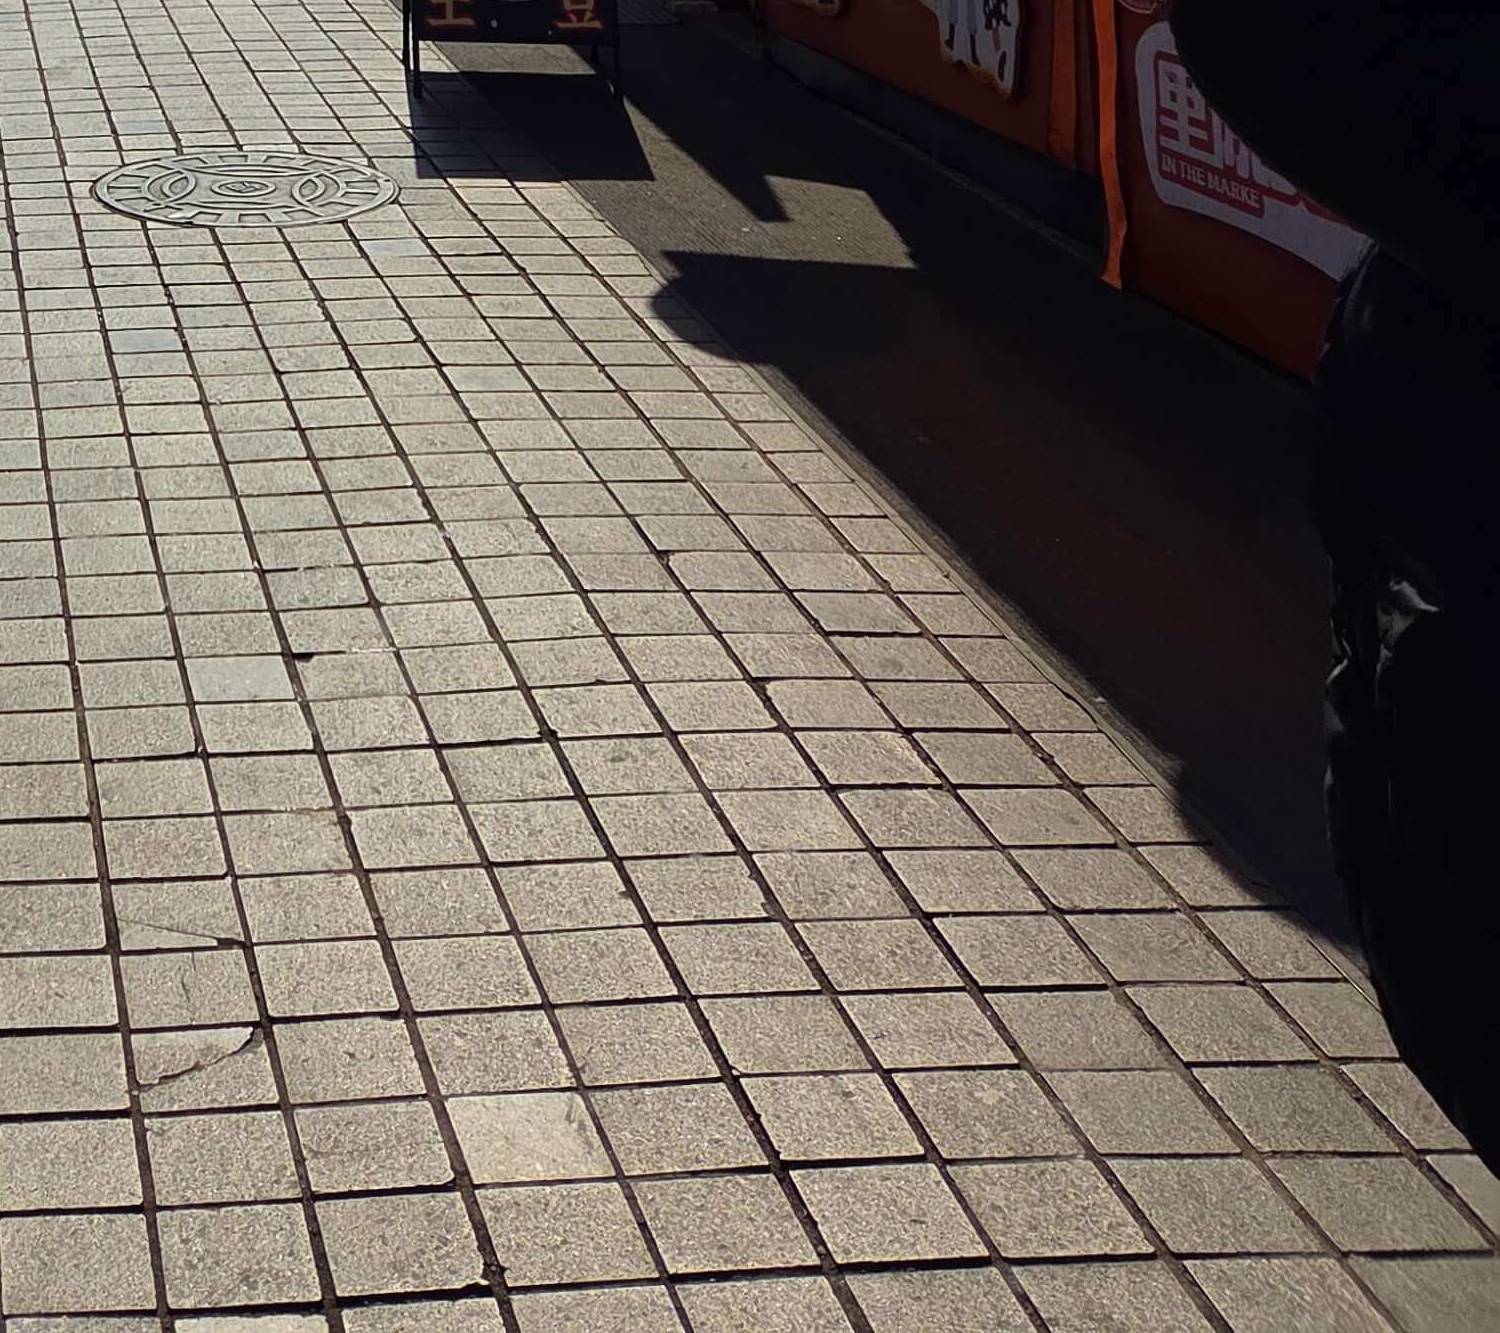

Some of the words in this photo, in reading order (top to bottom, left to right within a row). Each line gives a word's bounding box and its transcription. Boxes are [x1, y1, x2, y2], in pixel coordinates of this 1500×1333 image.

[1161, 152, 1177, 173] IN
[1178, 162, 1206, 186] THE
[1207, 170, 1262, 208] MARKE
